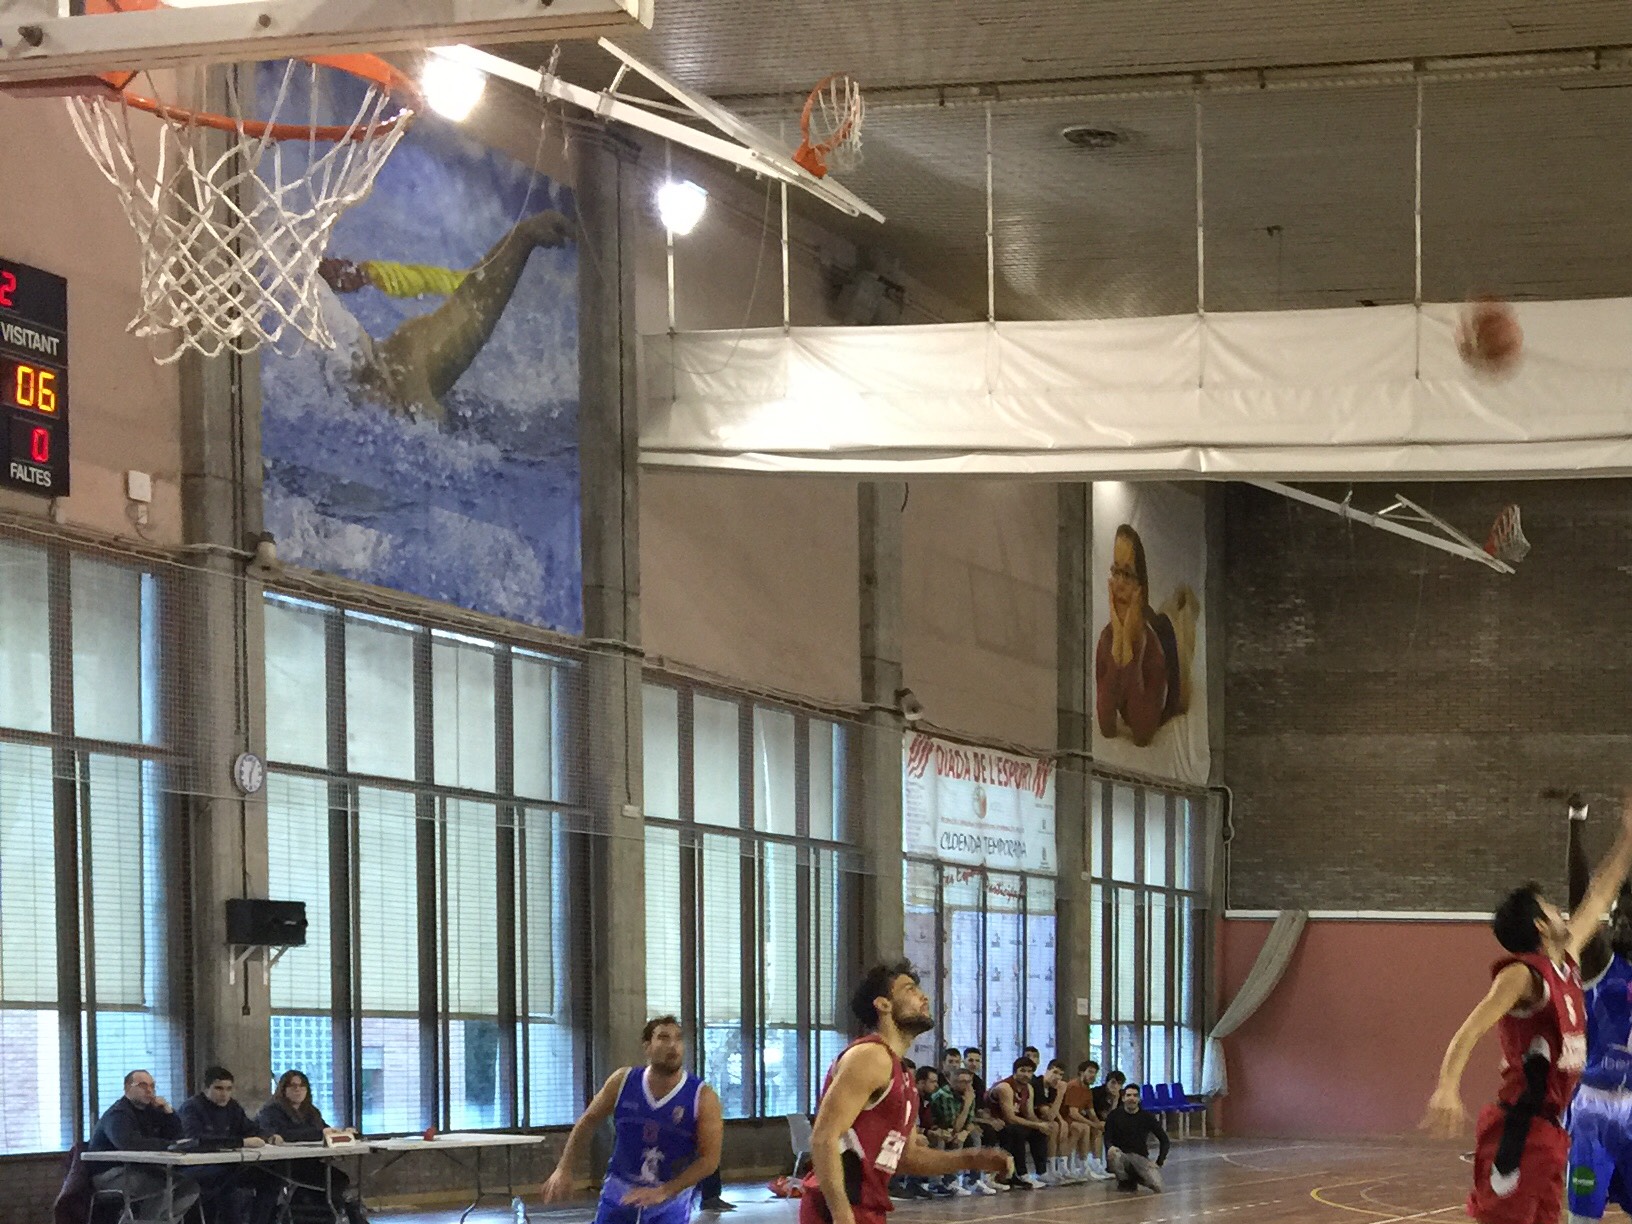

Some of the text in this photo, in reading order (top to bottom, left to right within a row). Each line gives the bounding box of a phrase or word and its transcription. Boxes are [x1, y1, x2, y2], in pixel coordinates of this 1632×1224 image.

[1, 321, 60, 356] VISITANT
[16, 365, 55, 412] 06
[31, 427, 49, 463] 0
[10, 463, 52, 487] FALTES
[935, 744, 971, 781] DIADA
[973, 752, 987, 783] DE
